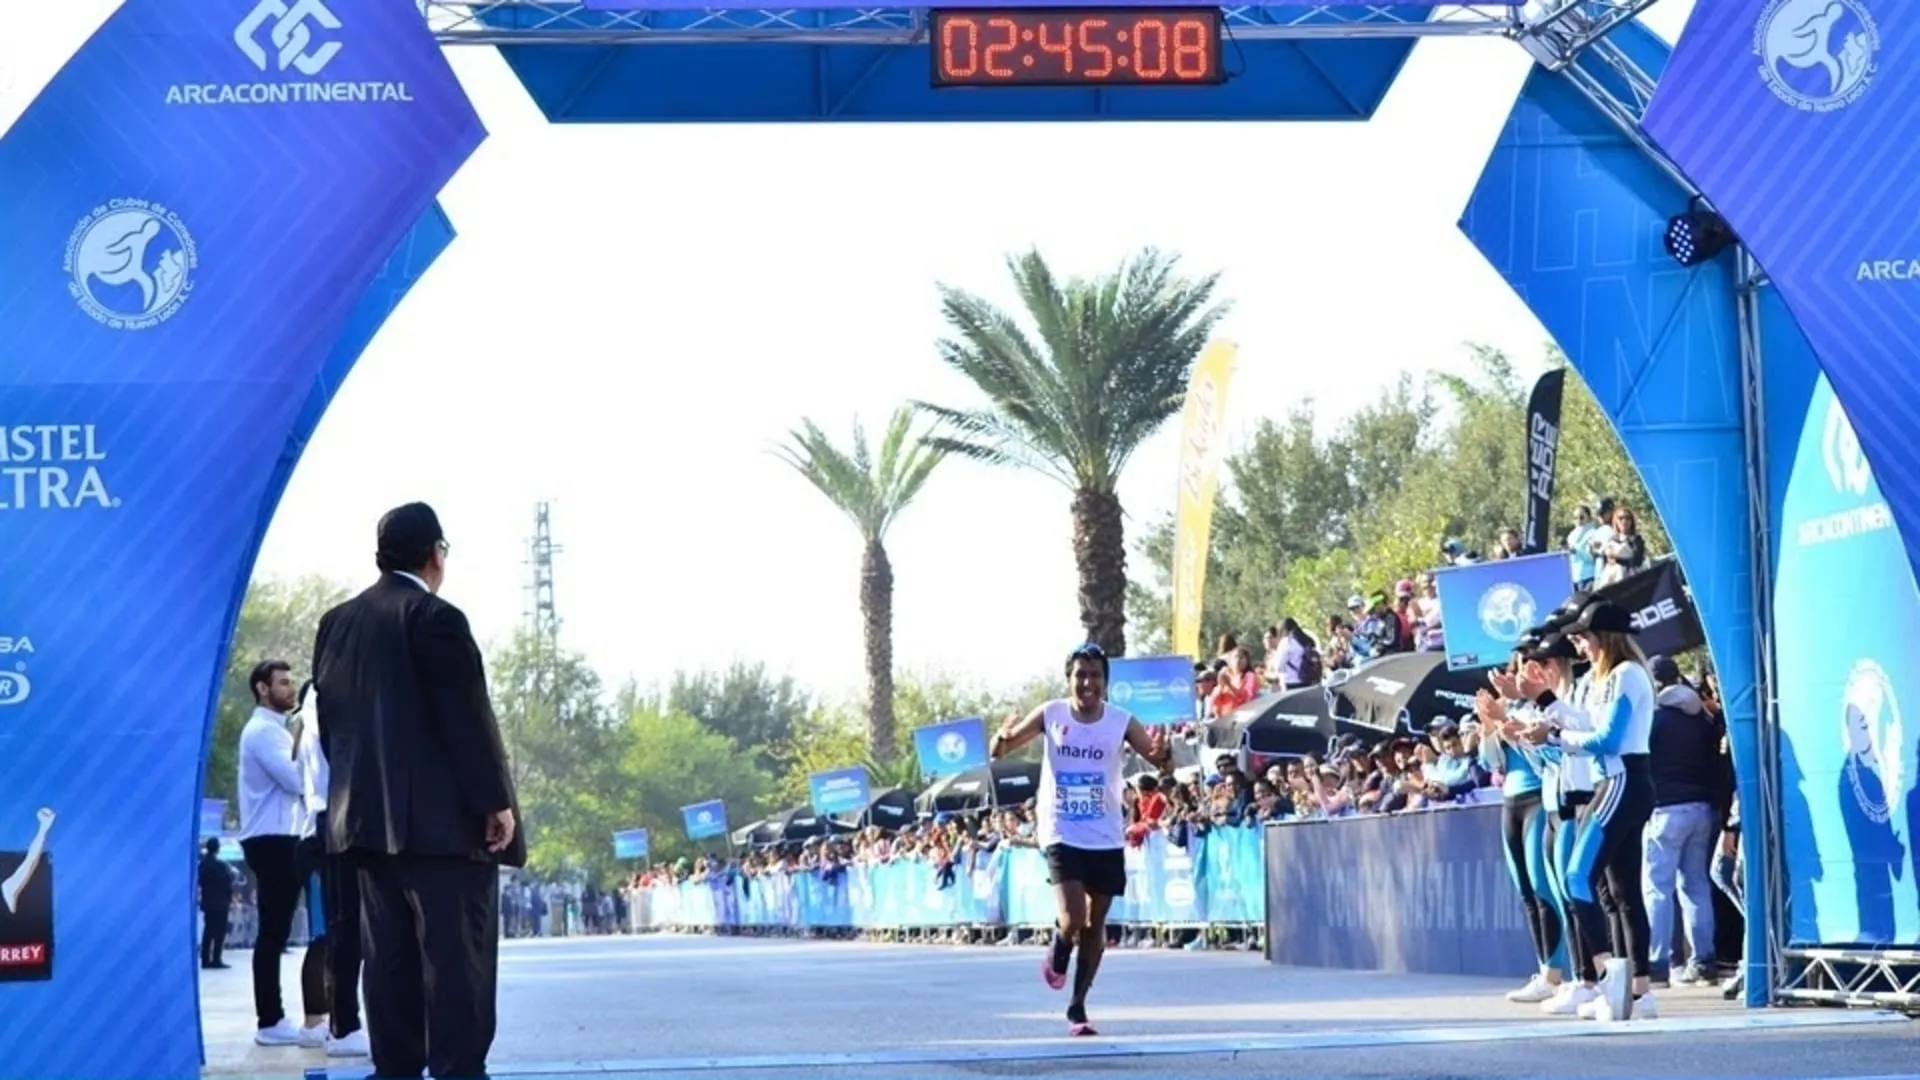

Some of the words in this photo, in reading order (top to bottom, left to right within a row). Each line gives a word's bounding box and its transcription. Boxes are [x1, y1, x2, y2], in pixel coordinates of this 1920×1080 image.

[944, 18, 1206, 78] 02:45:08
[166, 81, 413, 104] ARCACONTINENTAL
[1856, 259, 1920, 280] ARCA
